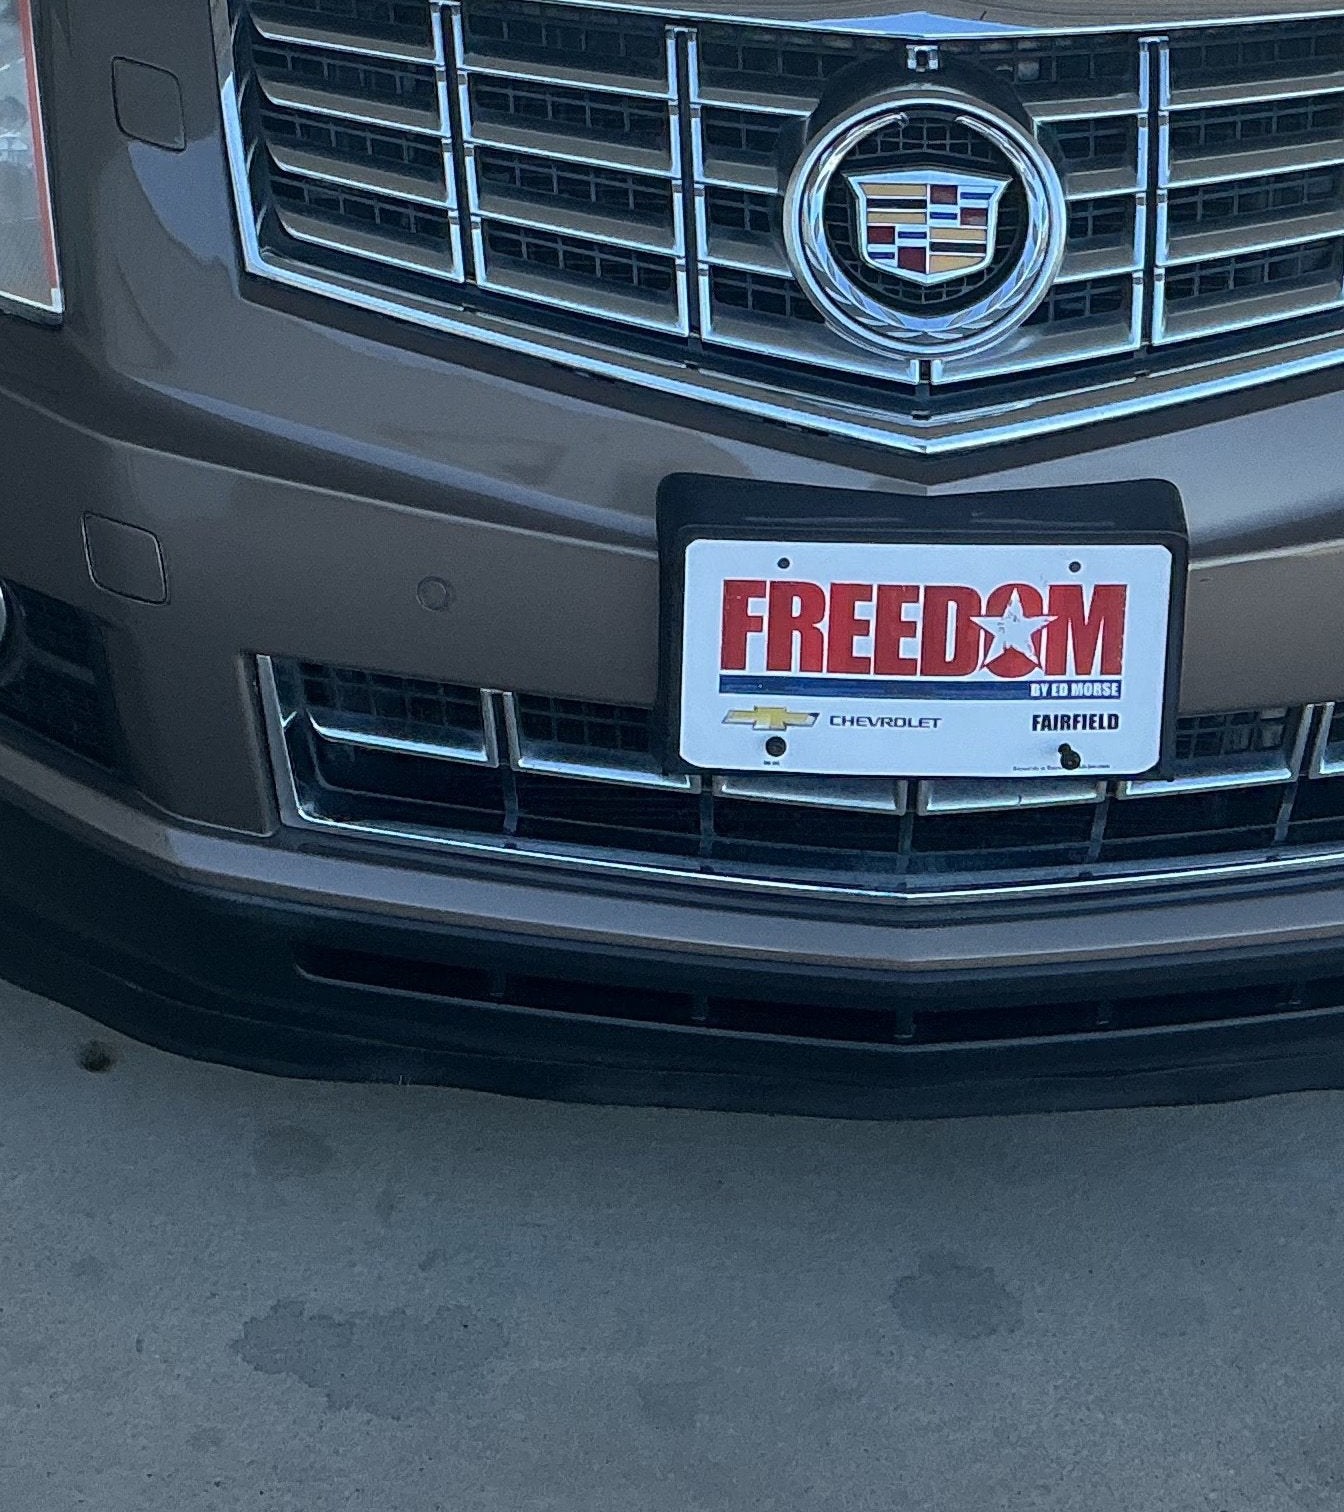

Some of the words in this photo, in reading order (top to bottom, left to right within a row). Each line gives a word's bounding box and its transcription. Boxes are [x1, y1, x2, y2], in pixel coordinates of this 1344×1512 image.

[720, 578, 1128, 679] FREEDOM
[1030, 682, 1050, 697] BY
[1051, 682, 1069, 697] ED
[1070, 681, 1120, 697] MORSE
[829, 715, 943, 729] CHEVROLET
[1031, 712, 1120, 732] FAIRFIELD
